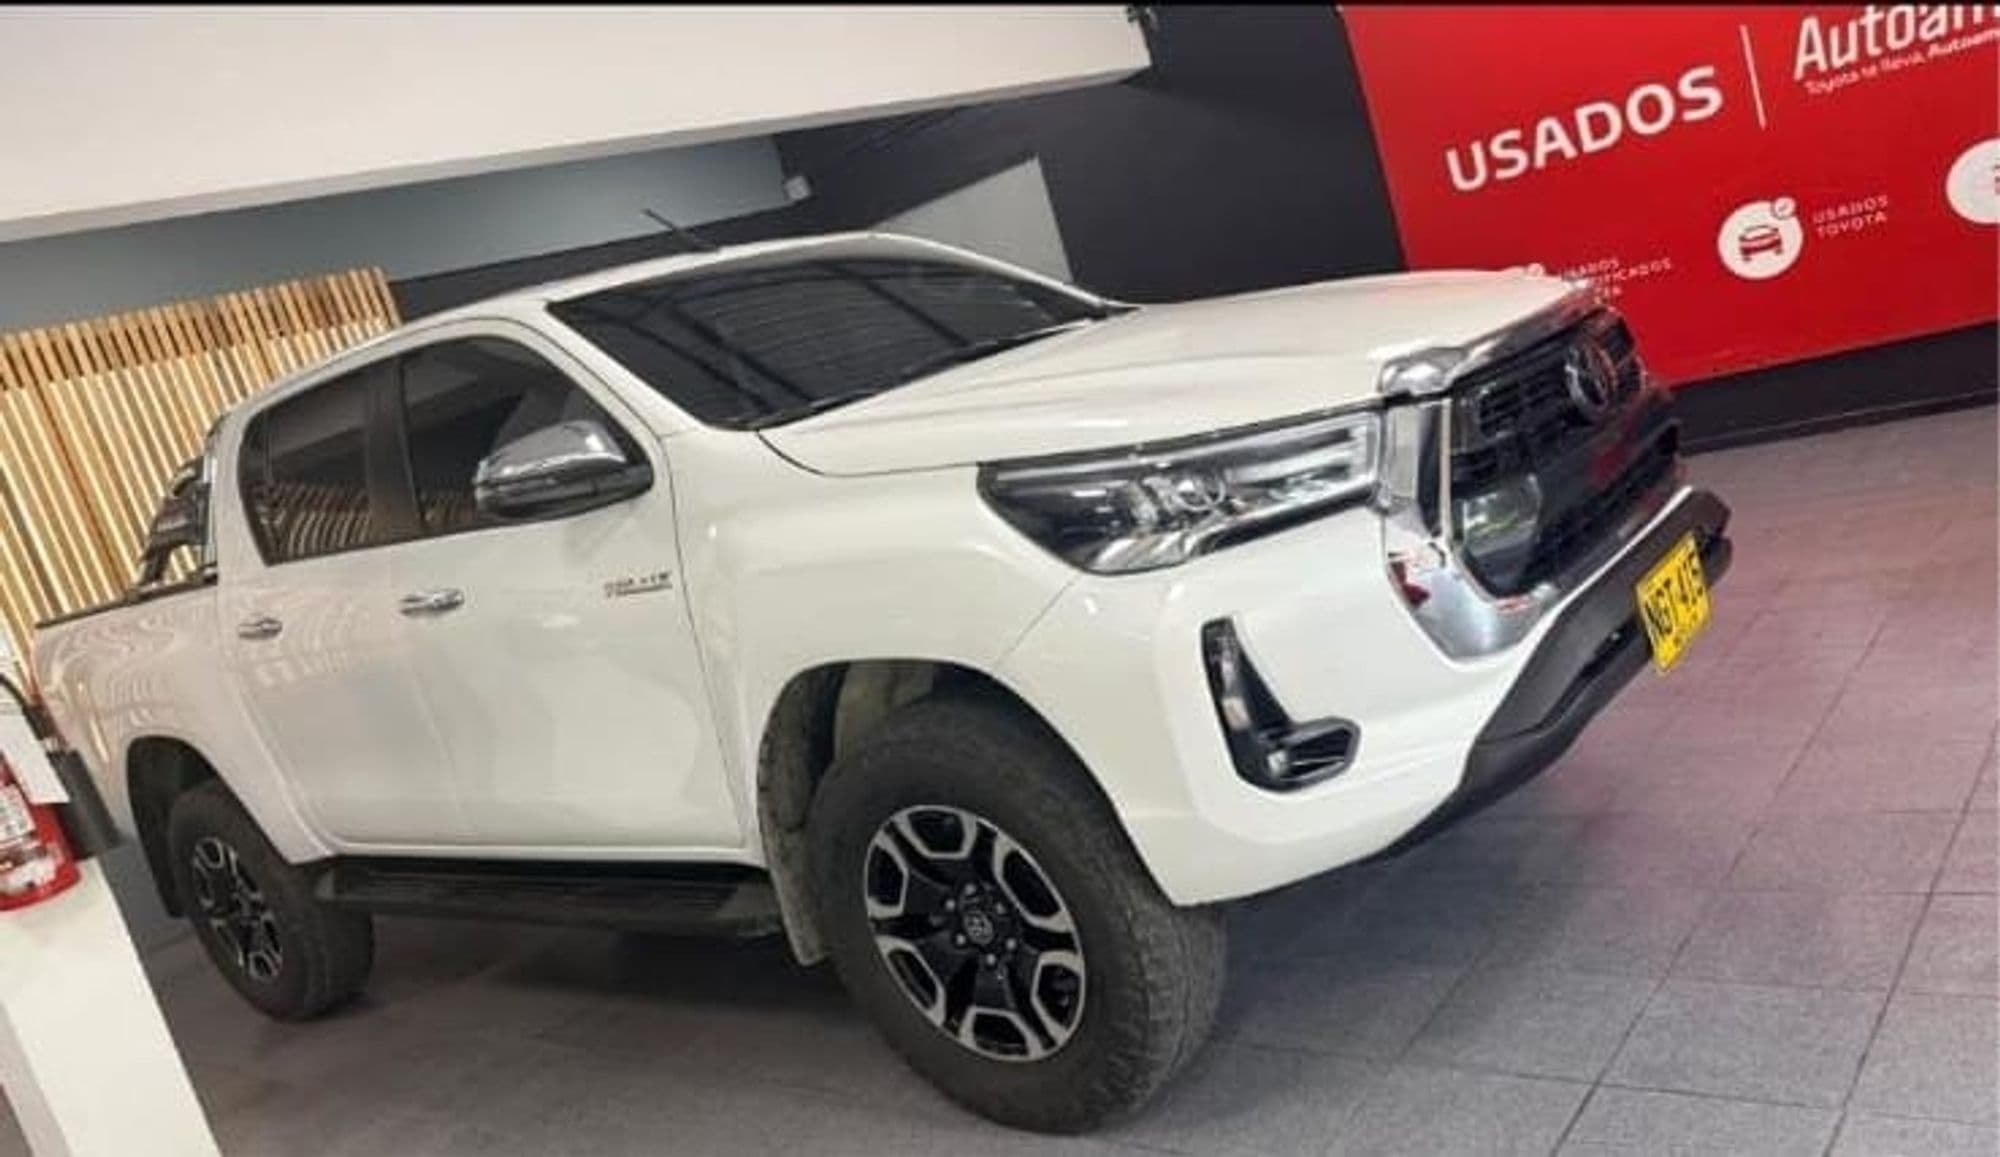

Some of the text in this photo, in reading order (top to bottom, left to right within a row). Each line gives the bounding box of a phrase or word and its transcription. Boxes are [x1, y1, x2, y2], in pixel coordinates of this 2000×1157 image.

[1805, 71, 1860, 94] Toyota
[1446, 65, 1723, 191] USADOS
[1812, 194, 1888, 224] USADOS
[1816, 211, 1888, 239] TOYOTA
